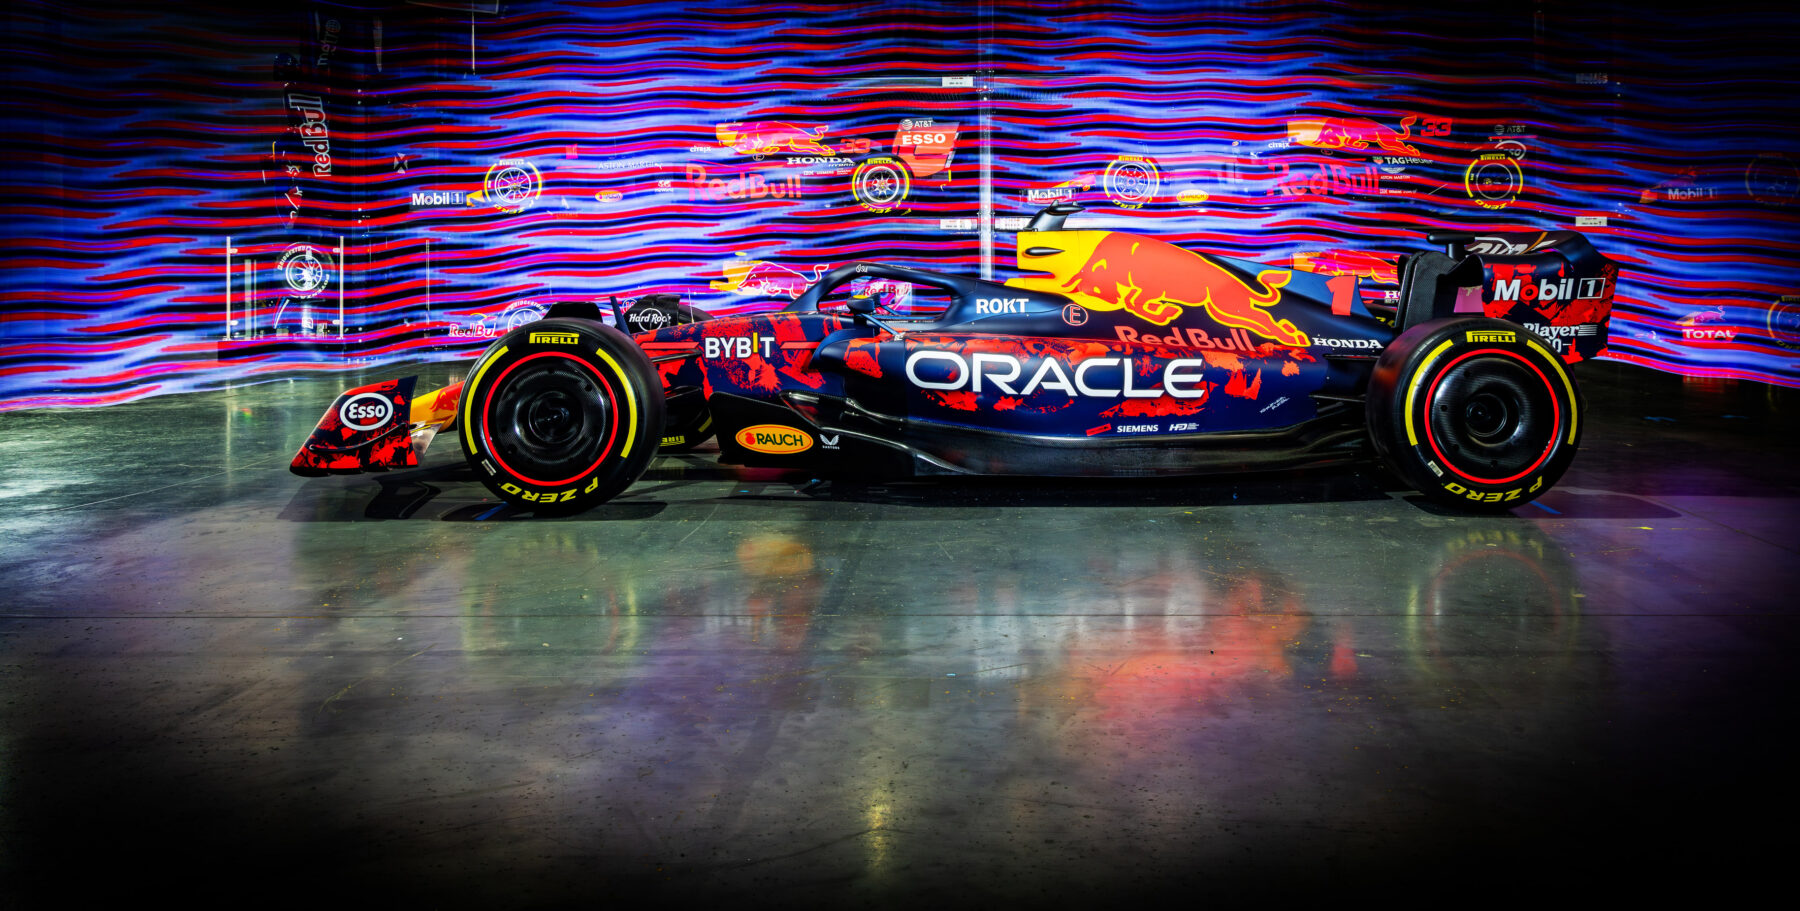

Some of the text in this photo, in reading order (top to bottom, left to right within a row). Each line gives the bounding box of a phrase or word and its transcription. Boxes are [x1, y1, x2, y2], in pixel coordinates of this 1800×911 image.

[1420, 118, 1453, 136] 33
[839, 138, 871, 154] 33
[902, 133, 946, 145] ESSO
[787, 156, 854, 165] HONDA
[1384, 156, 1405, 165] TAG
[686, 163, 801, 202] Red Bull
[1267, 162, 1379, 196] Red Bull
[412, 192, 450, 206] Mobil
[1028, 188, 1063, 201] Mobil
[1668, 187, 1703, 200] Mobil
[860, 202, 892, 213] ZERO
[1325, 275, 1357, 316] 1
[1494, 278, 1574, 302] Mobil
[976, 298, 1029, 314] ROKT
[629, 313, 651, 323] Hard
[449, 322, 475, 338] Red
[1466, 331, 1516, 343] PIRELLI
[1683, 328, 1736, 339] TOTAL
[529, 332, 579, 344] PIRELLI
[705, 332, 775, 359] BYBIT
[1114, 325, 1255, 352] Red Bull
[1311, 337, 1384, 349] HONDA
[905, 350, 1206, 398] ORACLE
[348, 402, 386, 420] Esso
[1116, 424, 1159, 432] SIEMENS
[756, 432, 803, 447] RAUCH
[499, 477, 599, 504] P ZERO
[1444, 475, 1543, 503] P ZERO
